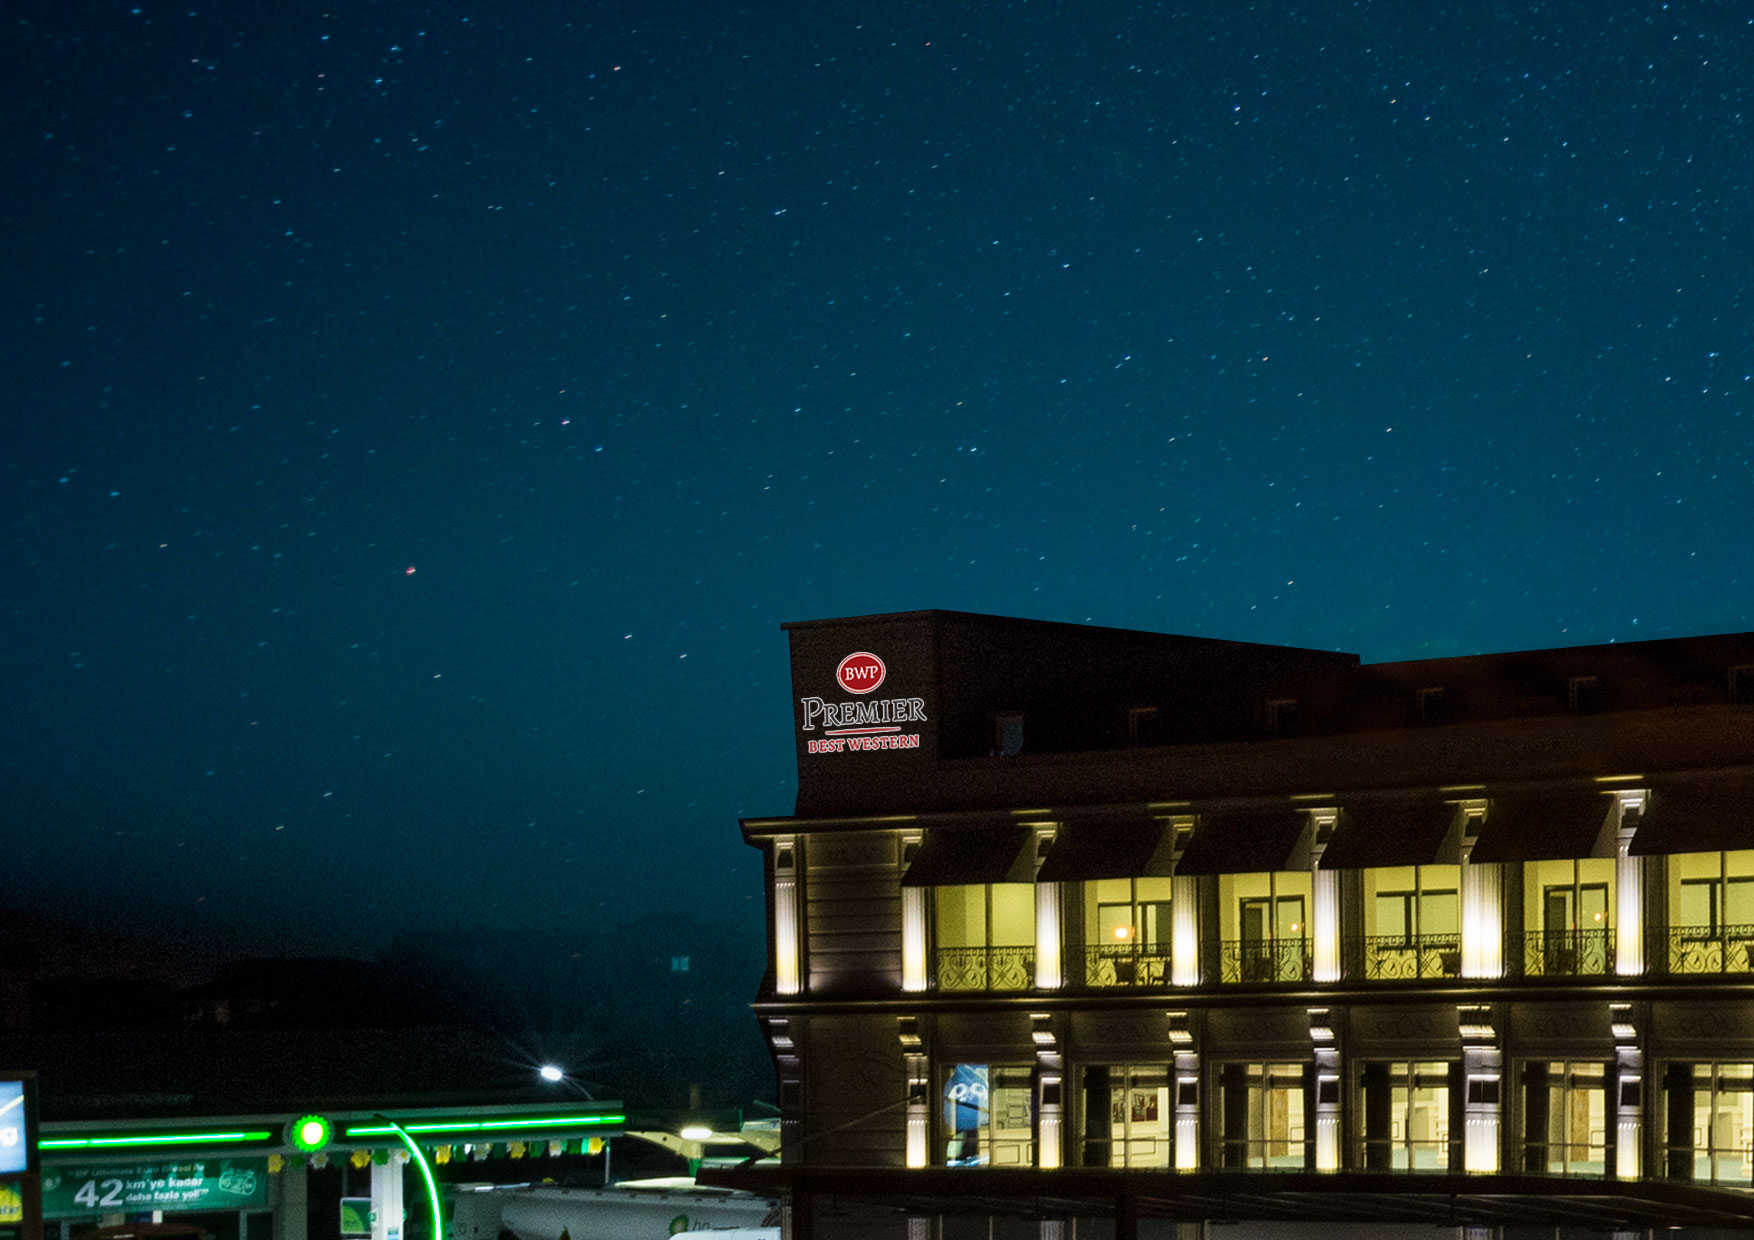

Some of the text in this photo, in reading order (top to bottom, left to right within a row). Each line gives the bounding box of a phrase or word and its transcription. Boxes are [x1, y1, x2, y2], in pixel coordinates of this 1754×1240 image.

[845, 665, 878, 681] BWP
[808, 734, 920, 753] BEST WESTERN
[74, 1178, 123, 1208] 42
